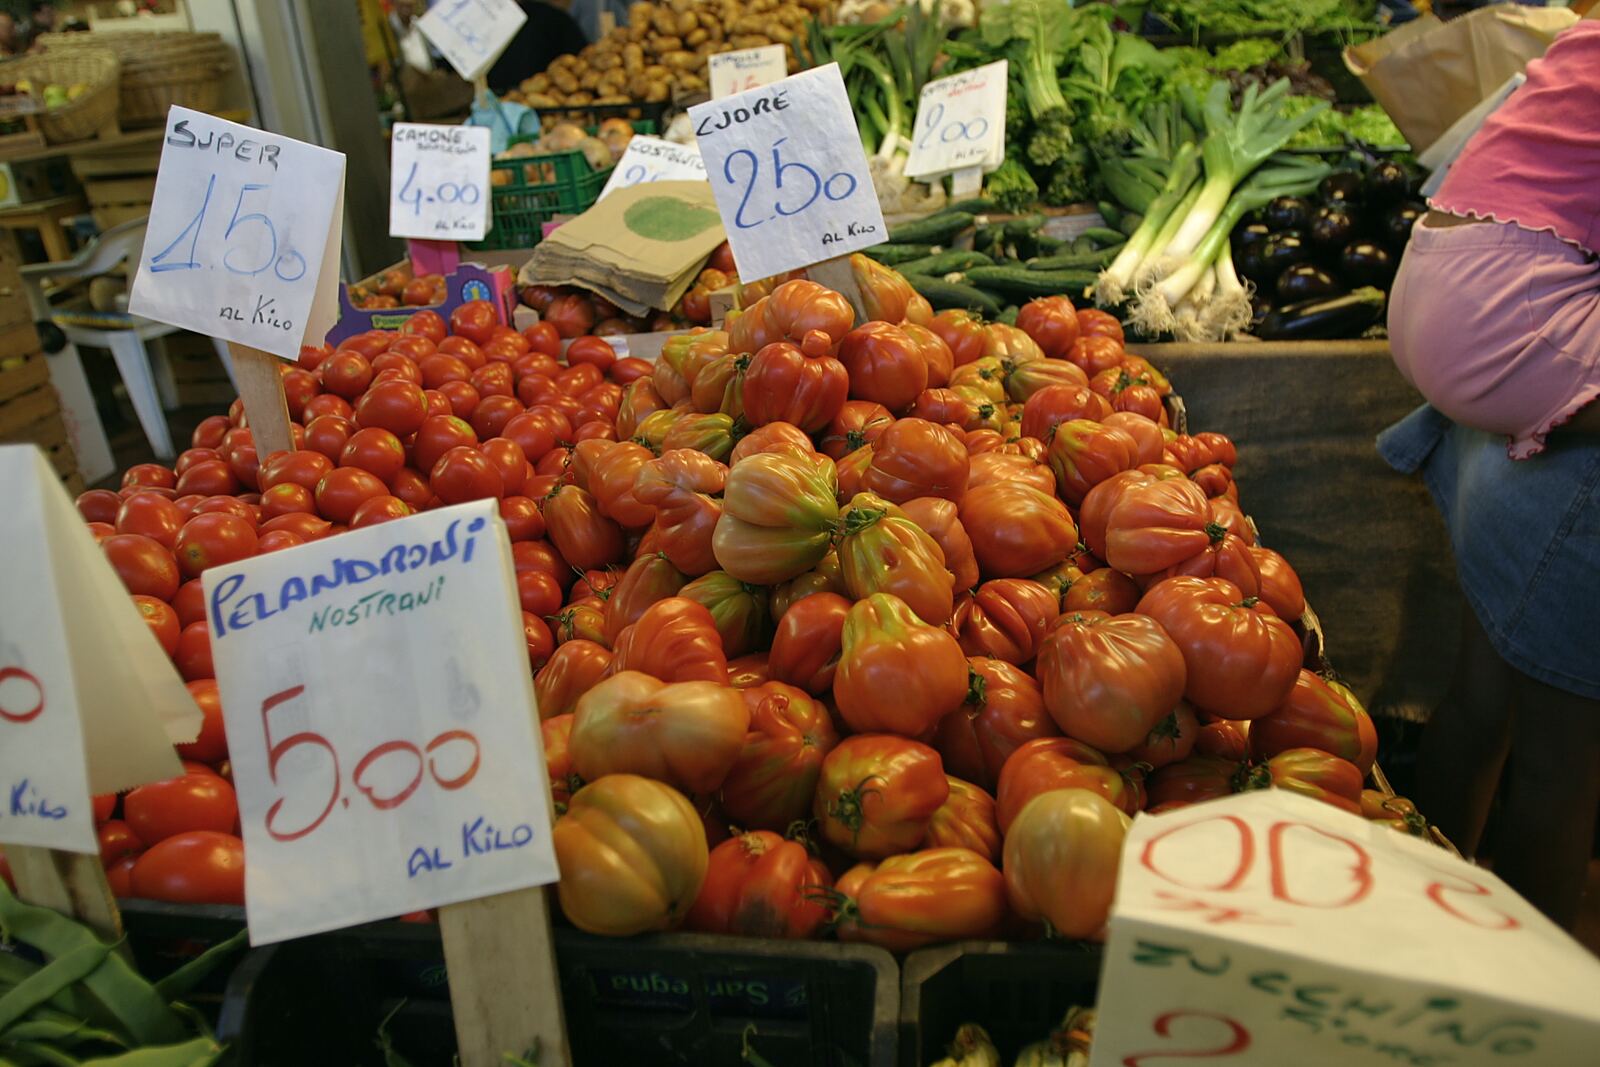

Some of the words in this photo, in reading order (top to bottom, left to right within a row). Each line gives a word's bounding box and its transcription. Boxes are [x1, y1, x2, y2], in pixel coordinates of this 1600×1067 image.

[167, 119, 281, 172] SUPER
[398, 161, 480, 216] 4.00
[149, 173, 307, 281] 1.50
[821, 232, 843, 245] AL
[219, 306, 244, 321] AL
[260, 684, 481, 842] 5.00
[407, 847, 452, 878] AL
